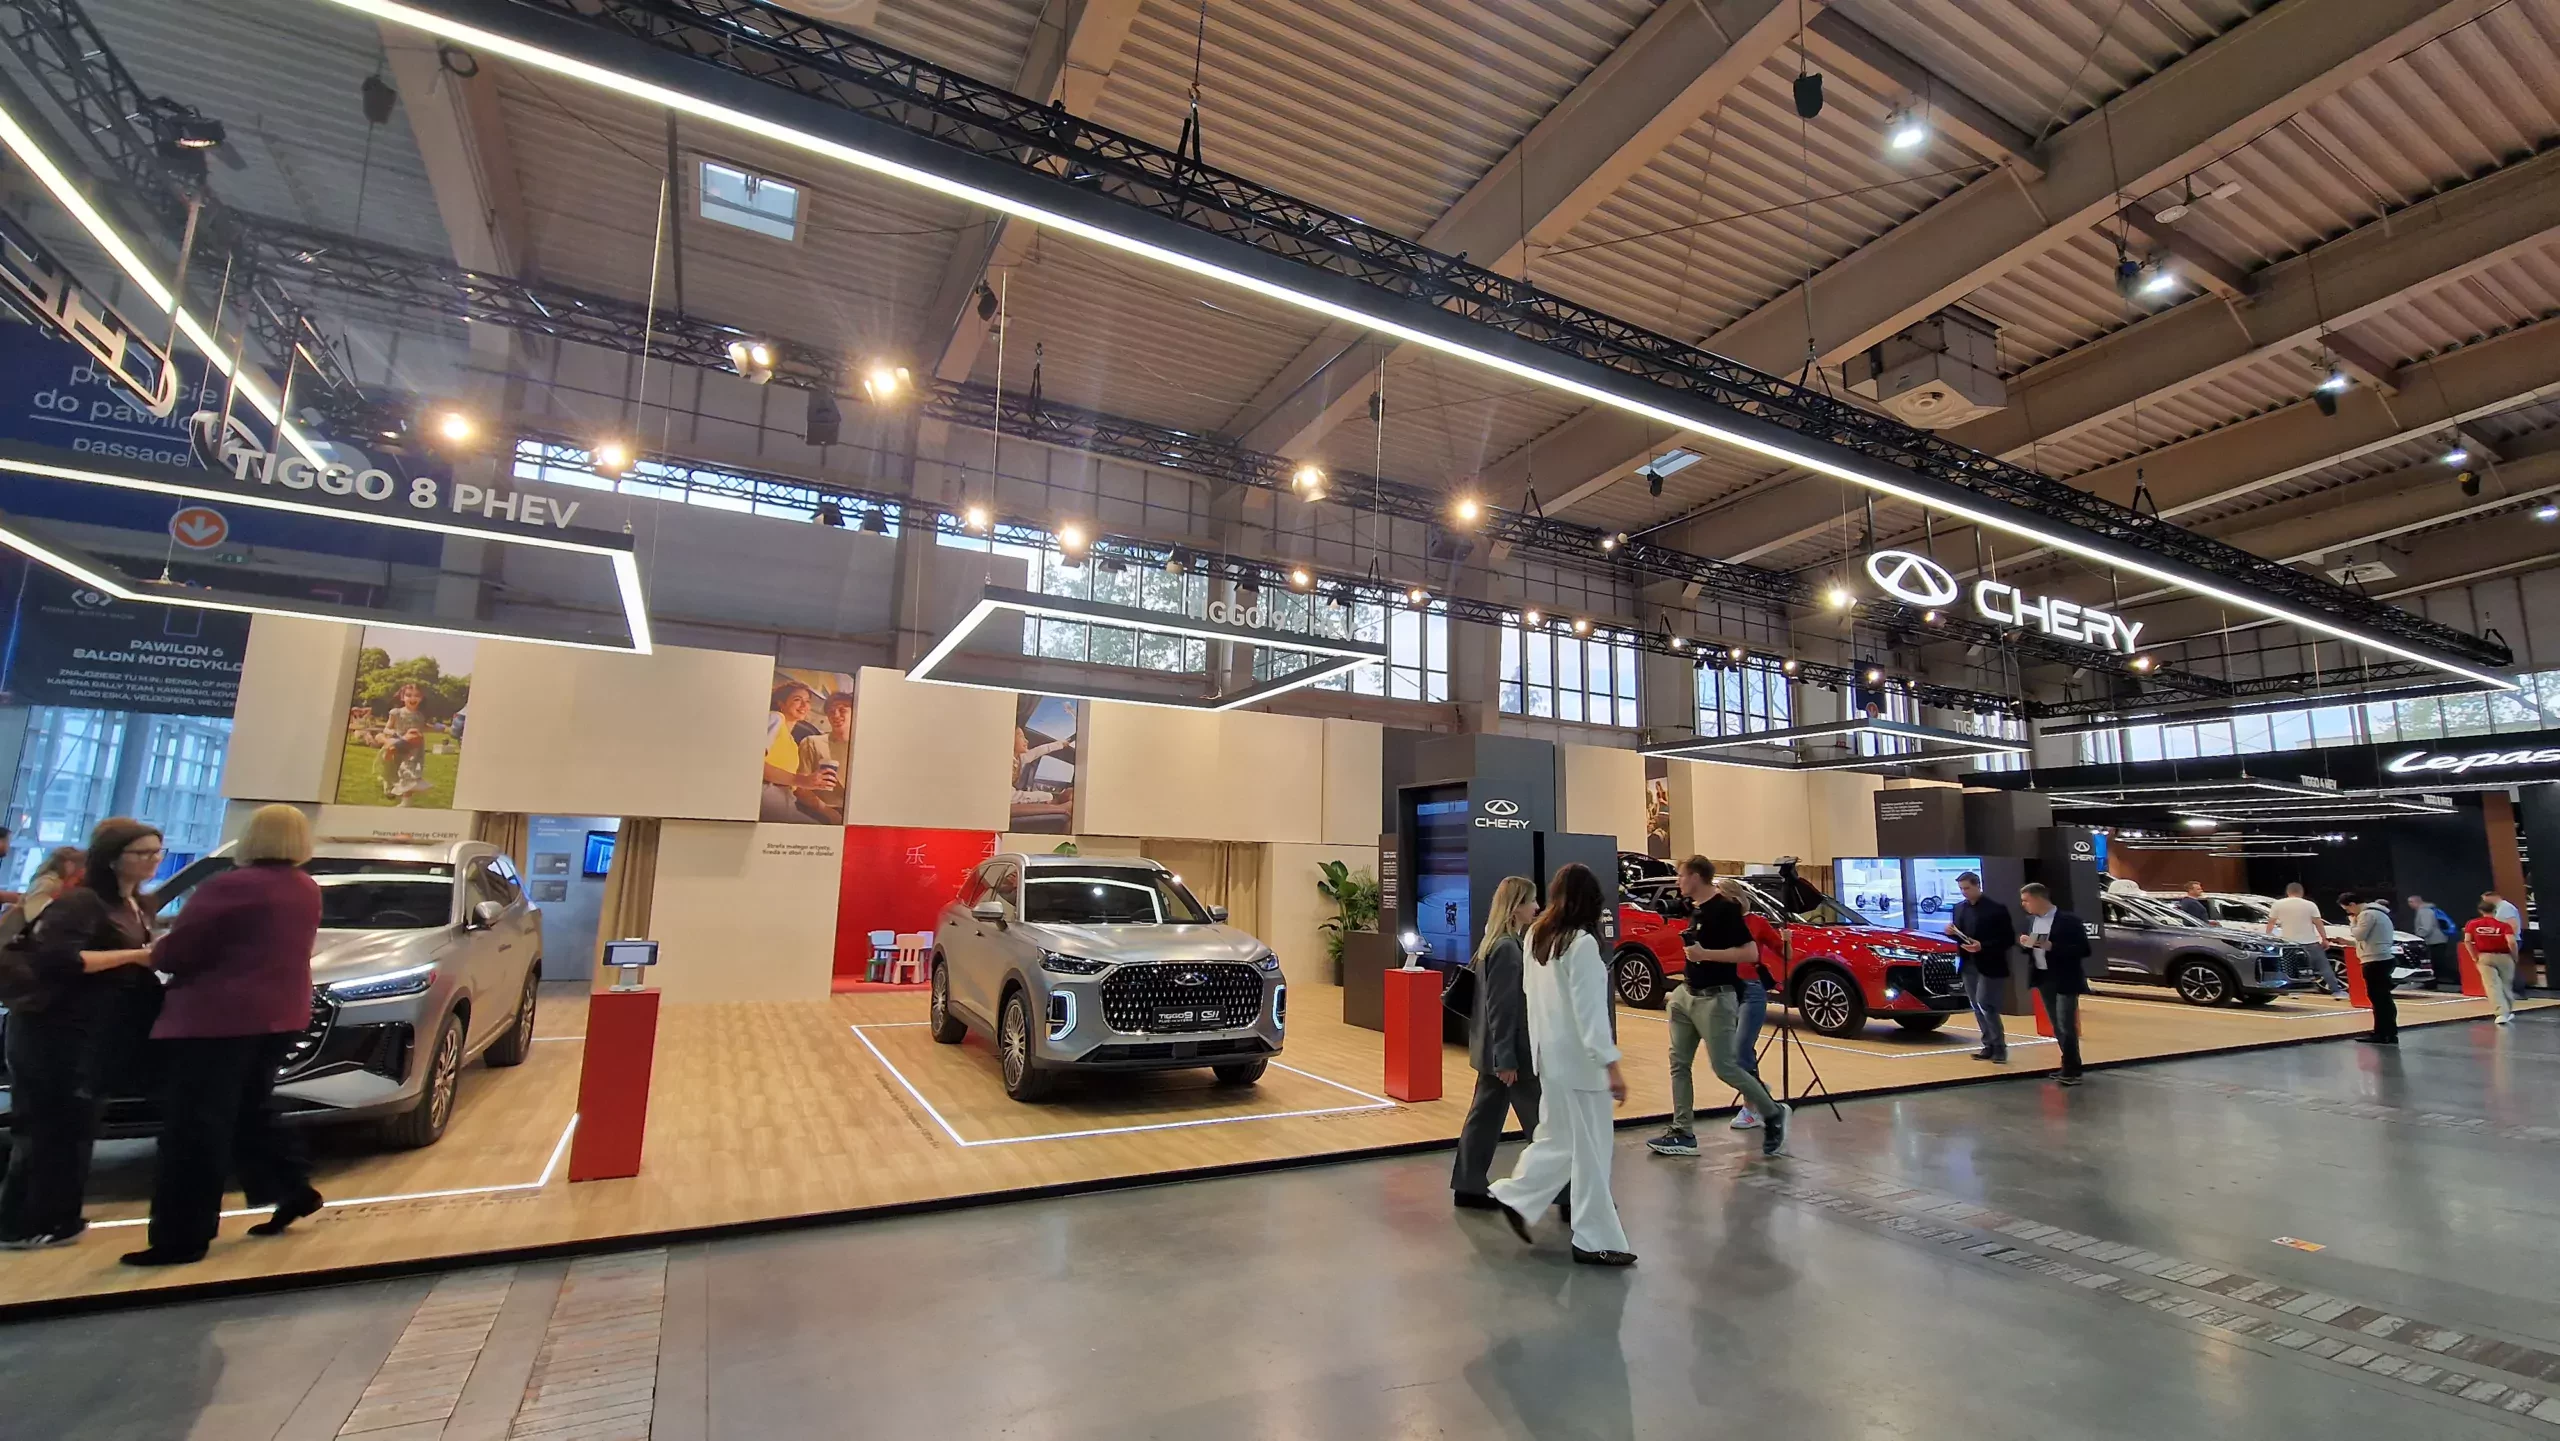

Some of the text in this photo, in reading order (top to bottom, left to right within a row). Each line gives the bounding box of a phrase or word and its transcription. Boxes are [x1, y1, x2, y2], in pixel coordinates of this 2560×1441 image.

[33, 388, 79, 413] do
[72, 437, 188, 467] passage
[228, 447, 580, 529] TIGGO 8 PHEV
[1272, 611, 1285, 632] 9
[1975, 579, 2144, 654] CHERY
[72, 648, 135, 663] SALON
[130, 639, 224, 656] PAWILON 6
[1475, 817, 1530, 829] CHERY
[905, 843, 927, 864] 乐
